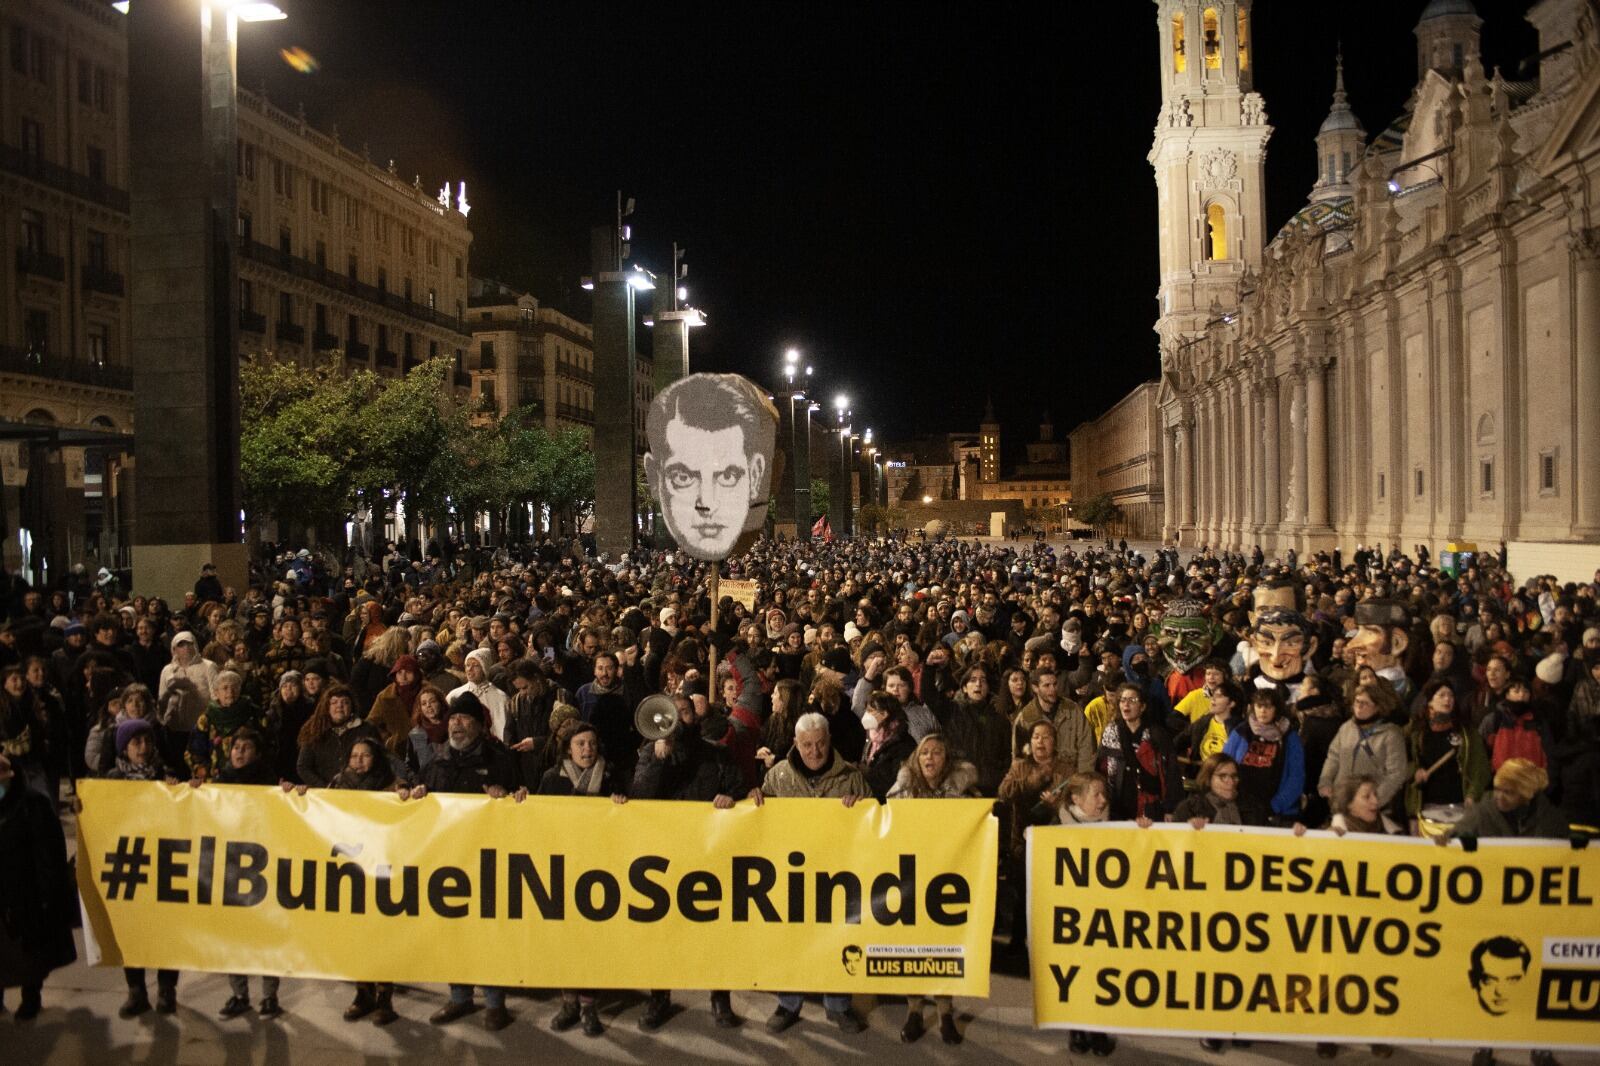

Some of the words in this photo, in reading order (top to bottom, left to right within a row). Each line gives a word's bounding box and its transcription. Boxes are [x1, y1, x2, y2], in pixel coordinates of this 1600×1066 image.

[100, 836, 971, 927] #ElBuñuelNoSeRinde
[1055, 847, 1130, 889] NO
[1145, 850, 1207, 890] AL
[1224, 852, 1483, 914] DESALOJO
[1502, 866, 1593, 905] DEL
[918, 946, 962, 954] COMUNITARIO
[1053, 906, 1270, 952] BARRIOS
[1285, 913, 1442, 958] VIVOS
[869, 960, 900, 975] LUIS
[903, 957, 962, 975] BUÑUEL
[1049, 964, 1080, 1003] Y
[1095, 968, 1400, 1015] SOLIDARIOS
